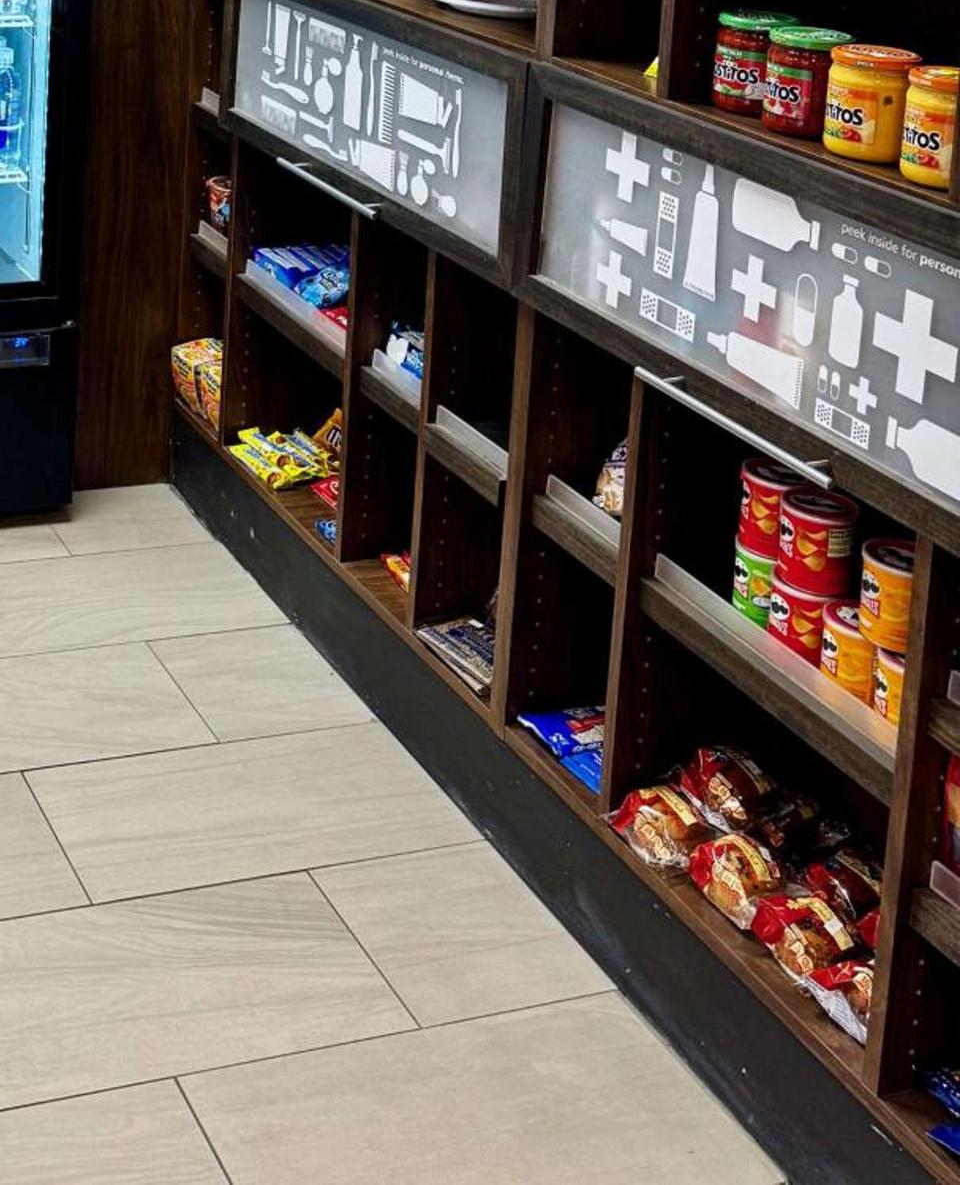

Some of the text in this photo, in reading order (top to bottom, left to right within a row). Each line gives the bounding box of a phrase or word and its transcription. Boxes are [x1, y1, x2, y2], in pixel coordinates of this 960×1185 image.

[841, 224, 866, 241] peek
[867, 231, 899, 254] inside
[901, 245, 918, 261] for
